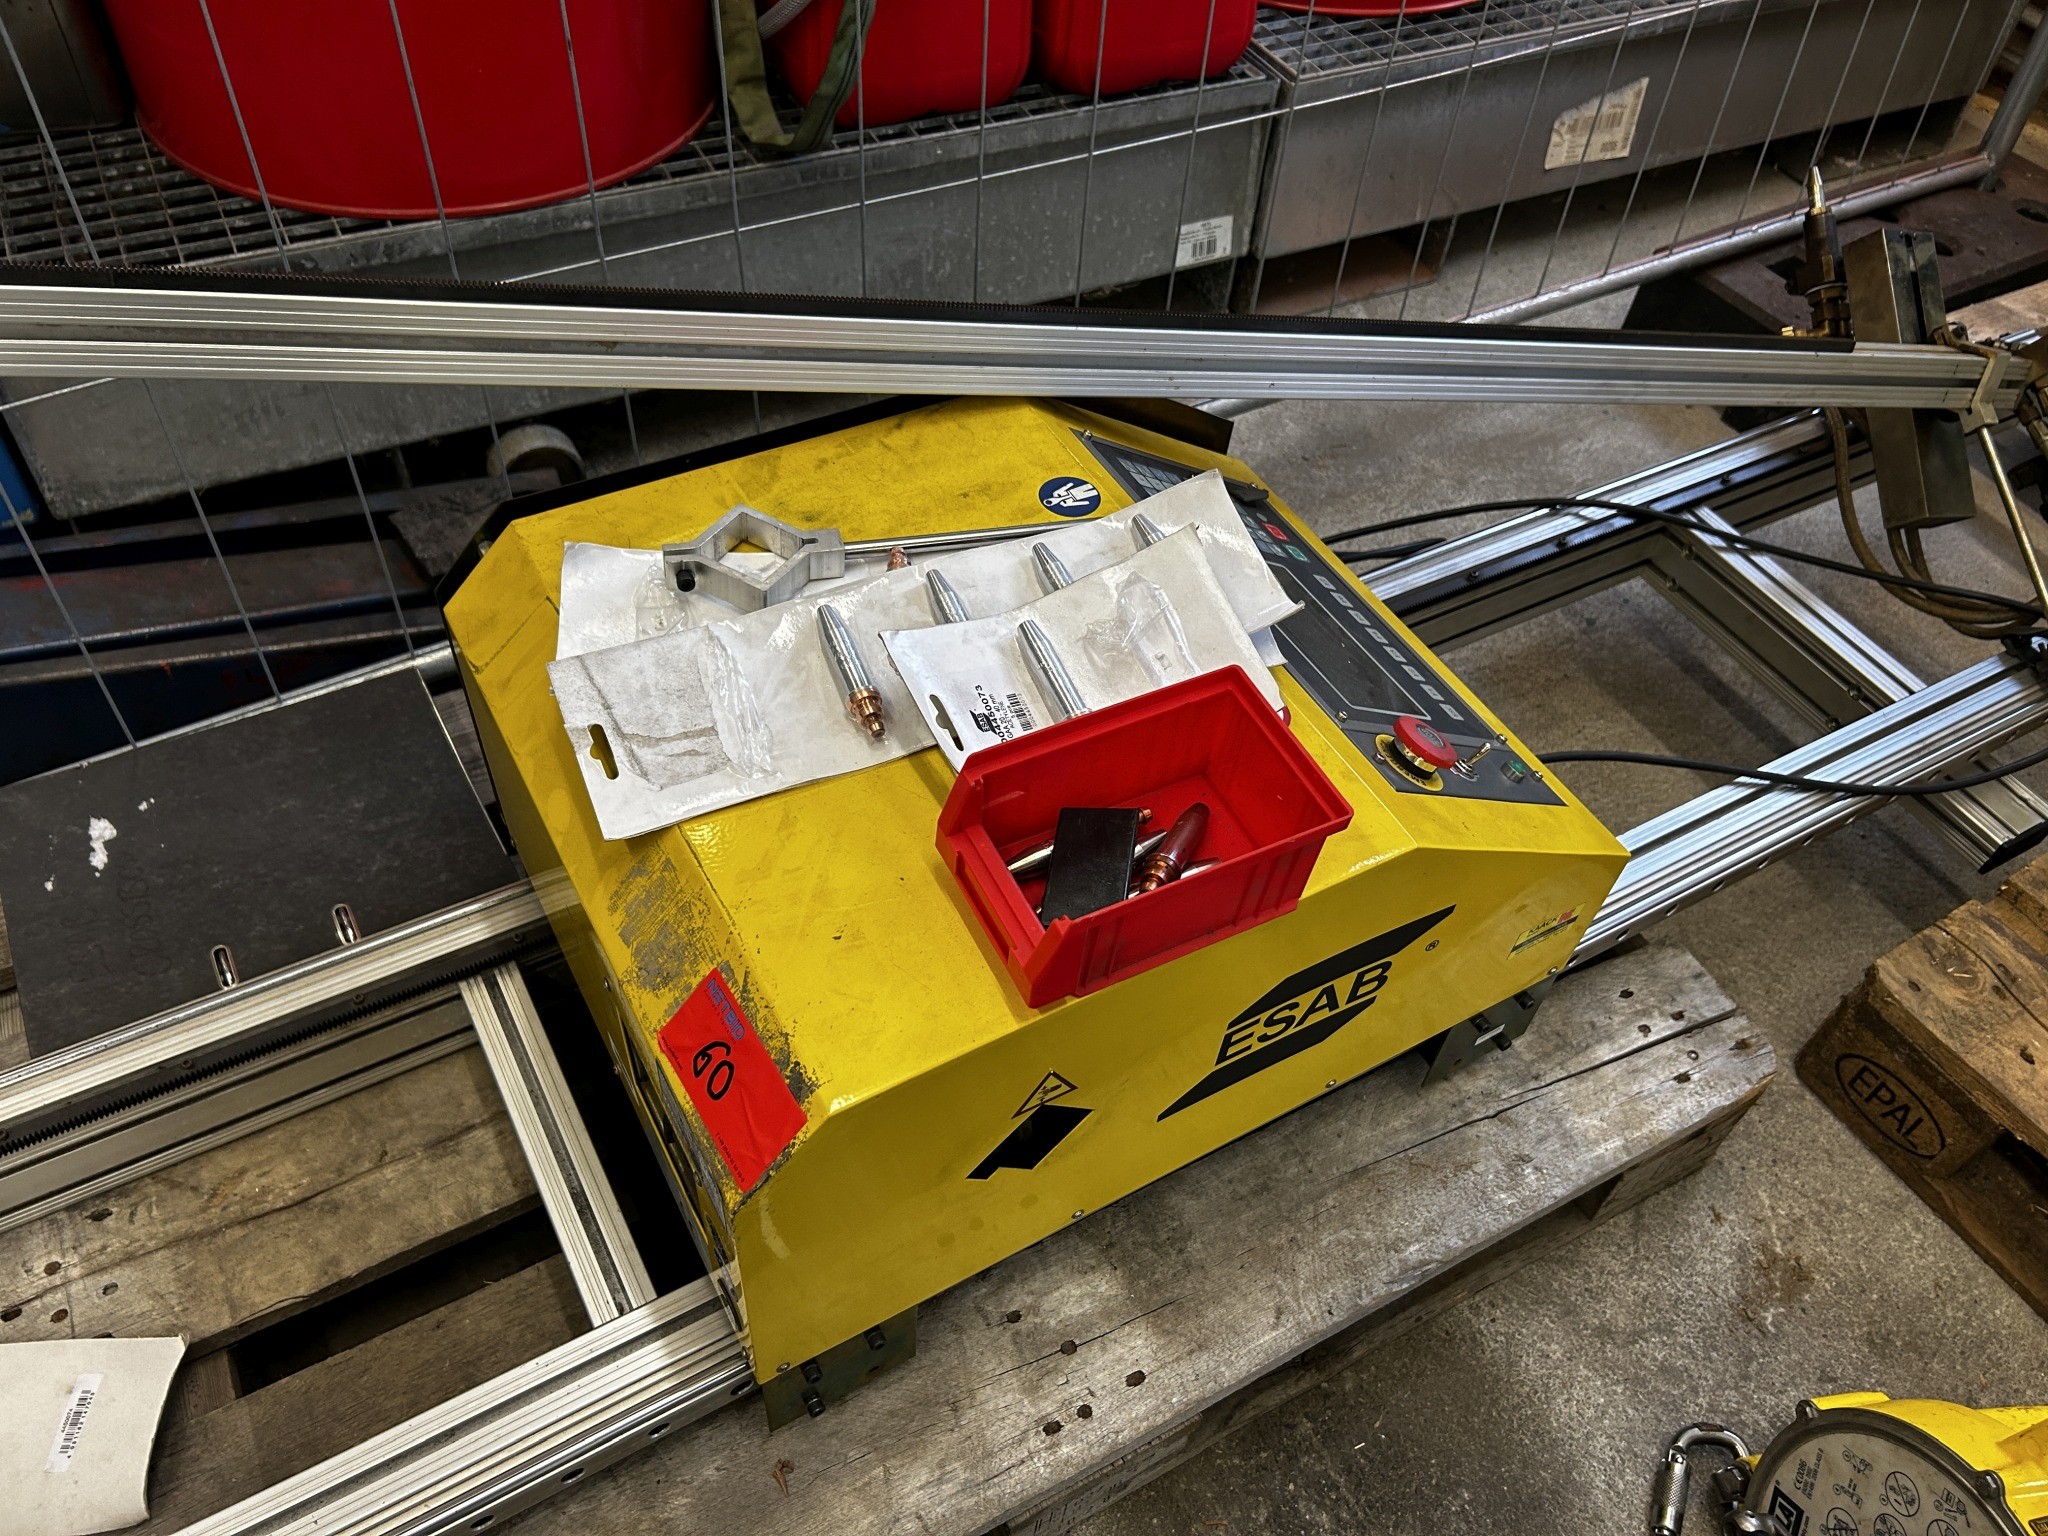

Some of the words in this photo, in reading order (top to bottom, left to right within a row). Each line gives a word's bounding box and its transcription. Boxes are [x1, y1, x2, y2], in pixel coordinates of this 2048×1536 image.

[976, 712, 990, 733] ESAB
[998, 700, 1015, 729] ACETYLENE
[1003, 725, 1014, 738] GAA
[706, 977, 746, 1040] NETBID
[1215, 960, 1393, 1066] ESAB
[692, 1041, 735, 1101] 60
[1847, 1065, 1925, 1150] EPAL
